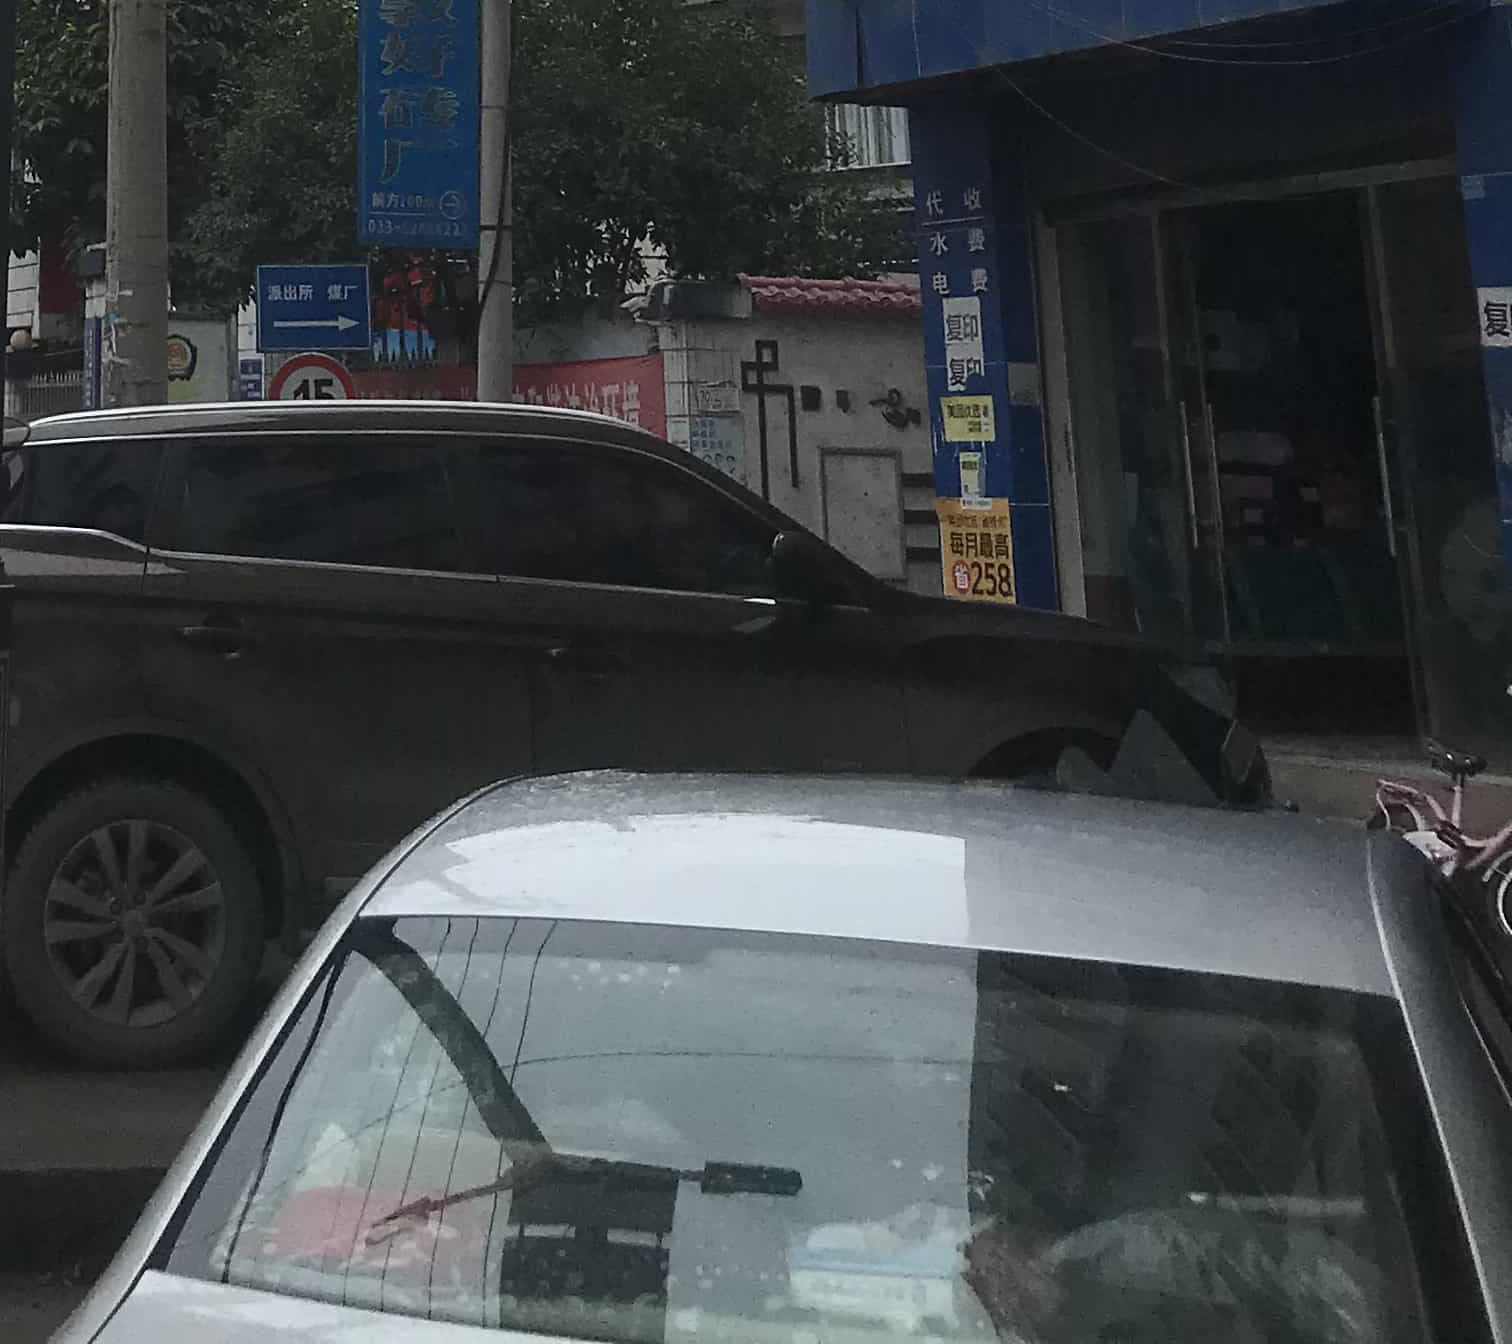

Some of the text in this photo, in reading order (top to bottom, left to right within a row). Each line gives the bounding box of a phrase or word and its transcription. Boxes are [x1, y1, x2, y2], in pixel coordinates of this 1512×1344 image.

[268, 284, 313, 301] 派出所
[946, 314, 979, 342] 复印
[1484, 301, 1512, 337] 复
[950, 531, 1009, 560] 每月最高
